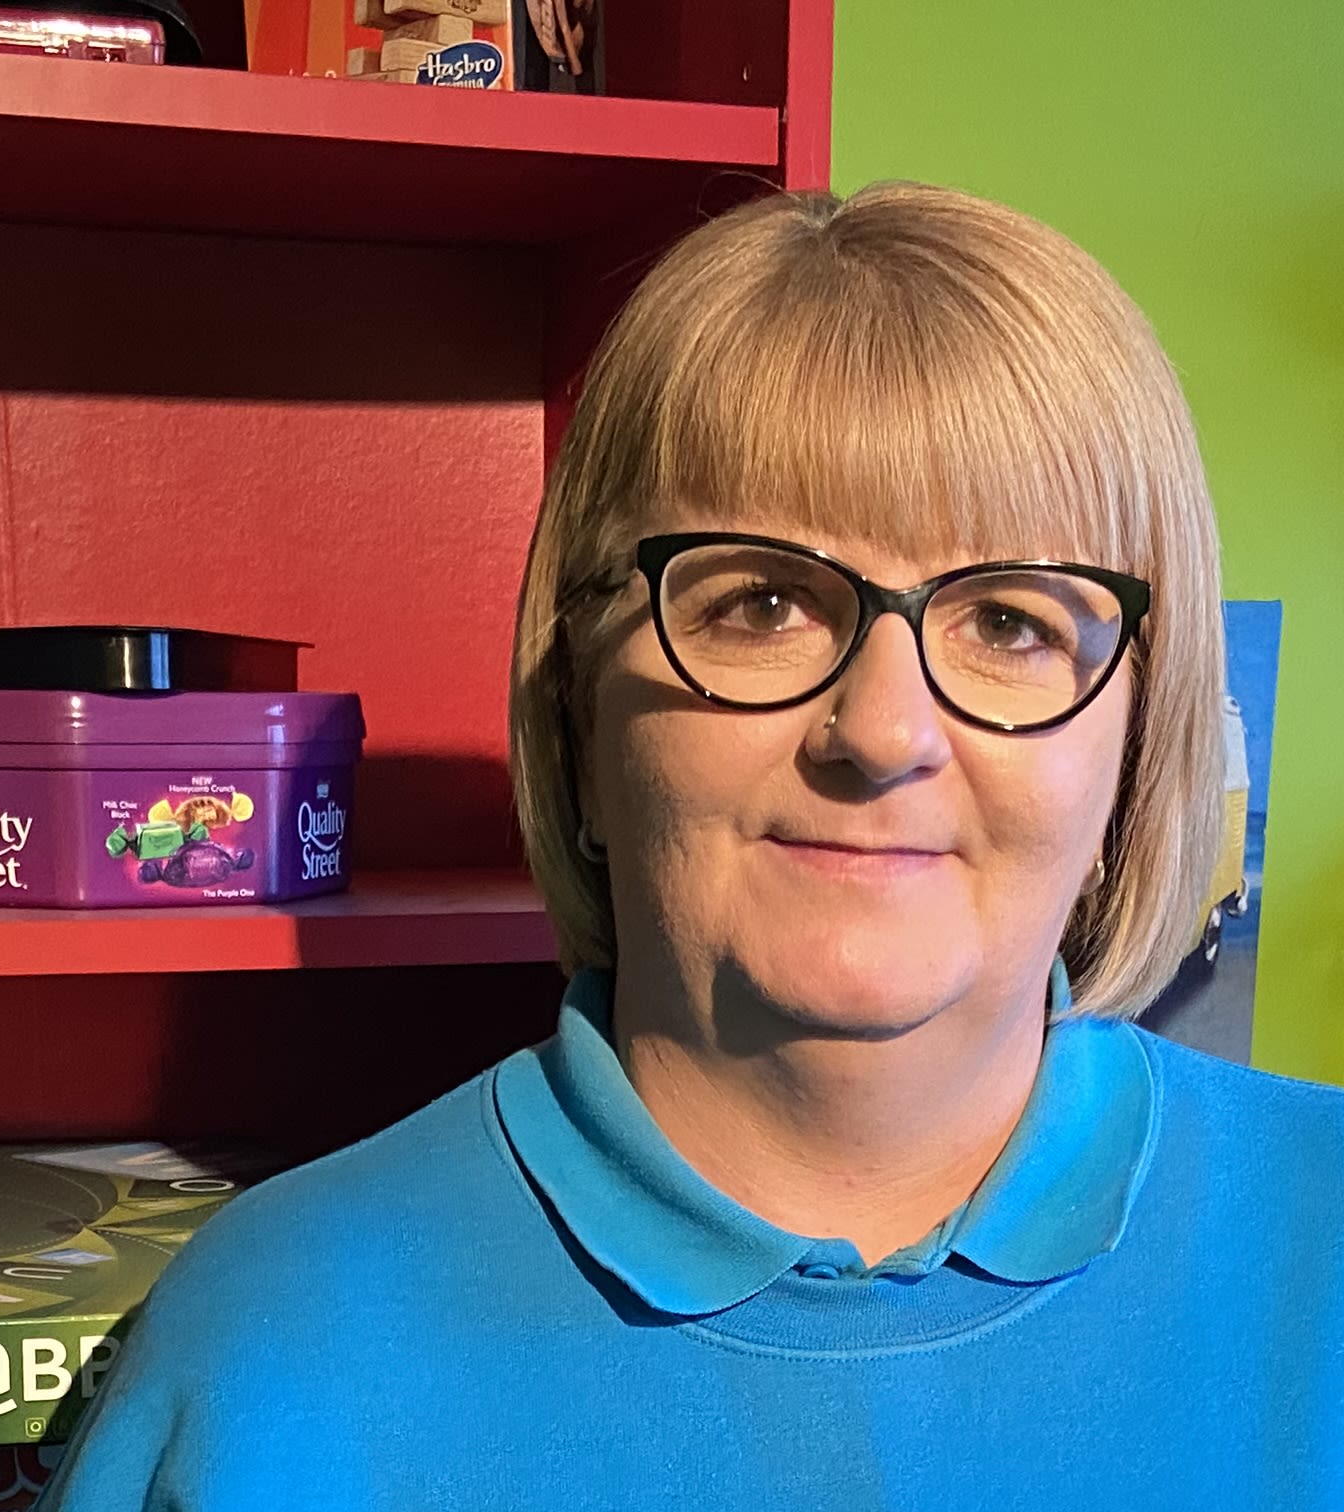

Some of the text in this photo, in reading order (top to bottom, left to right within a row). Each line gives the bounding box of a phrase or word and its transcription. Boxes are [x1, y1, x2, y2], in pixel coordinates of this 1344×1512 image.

[420, 52, 496, 78] Hasbro
[191, 776, 212, 785] NEW
[298, 802, 347, 849] Quality
[301, 846, 343, 880] Street
